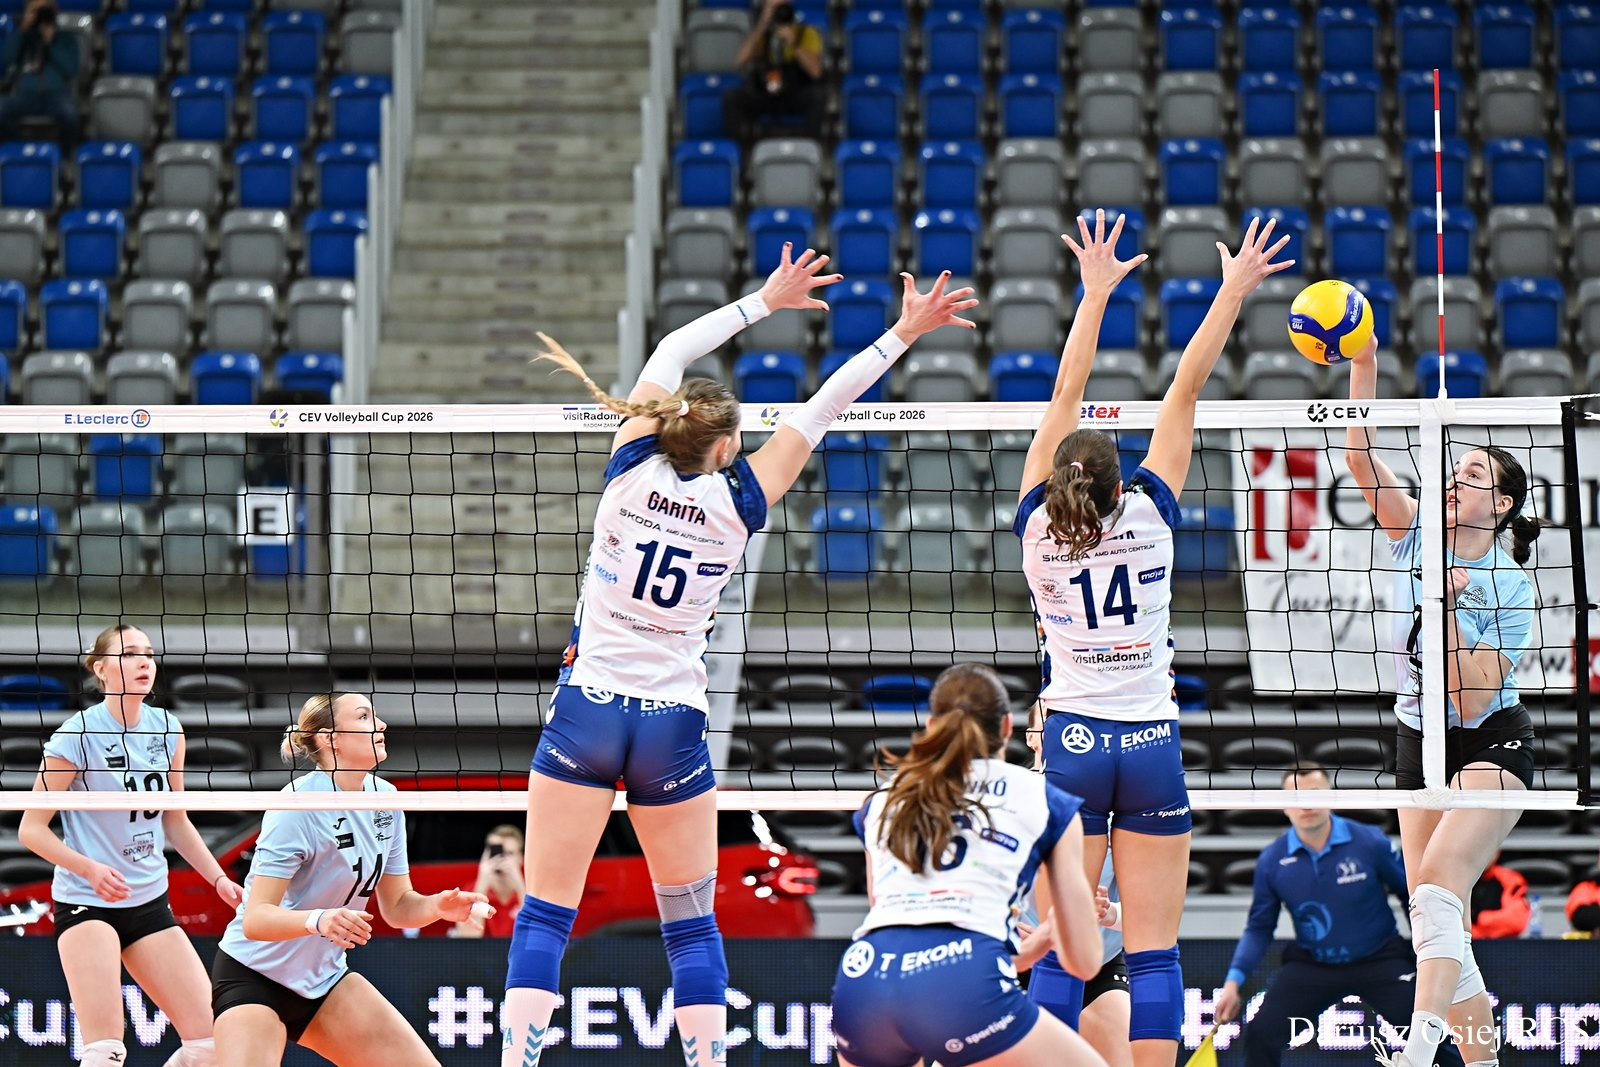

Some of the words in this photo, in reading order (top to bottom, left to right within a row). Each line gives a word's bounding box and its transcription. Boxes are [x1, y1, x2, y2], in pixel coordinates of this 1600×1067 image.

[64, 413, 129, 425] E.Leclerc
[299, 412, 322, 422] CEV
[325, 411, 379, 424] Volleyball
[382, 412, 404, 424] Cup
[407, 412, 434, 422] 2026
[836, 410, 870, 422] eyball
[874, 410, 896, 422] Cup
[899, 410, 926, 420] 2026
[1080, 404, 1121, 419] etex
[1333, 406, 1370, 419] CEV
[647, 491, 707, 526] GARITA
[253, 508, 276, 535] E
[680, 532, 697, 541] AUTO
[1094, 550, 1109, 558] AMD
[1109, 547, 1128, 555] AUTO
[1128, 543, 1156, 553] CENTRUM
[632, 540, 693, 609] 15
[1069, 564, 1138, 630] 14
[343, 853, 383, 907] 14
